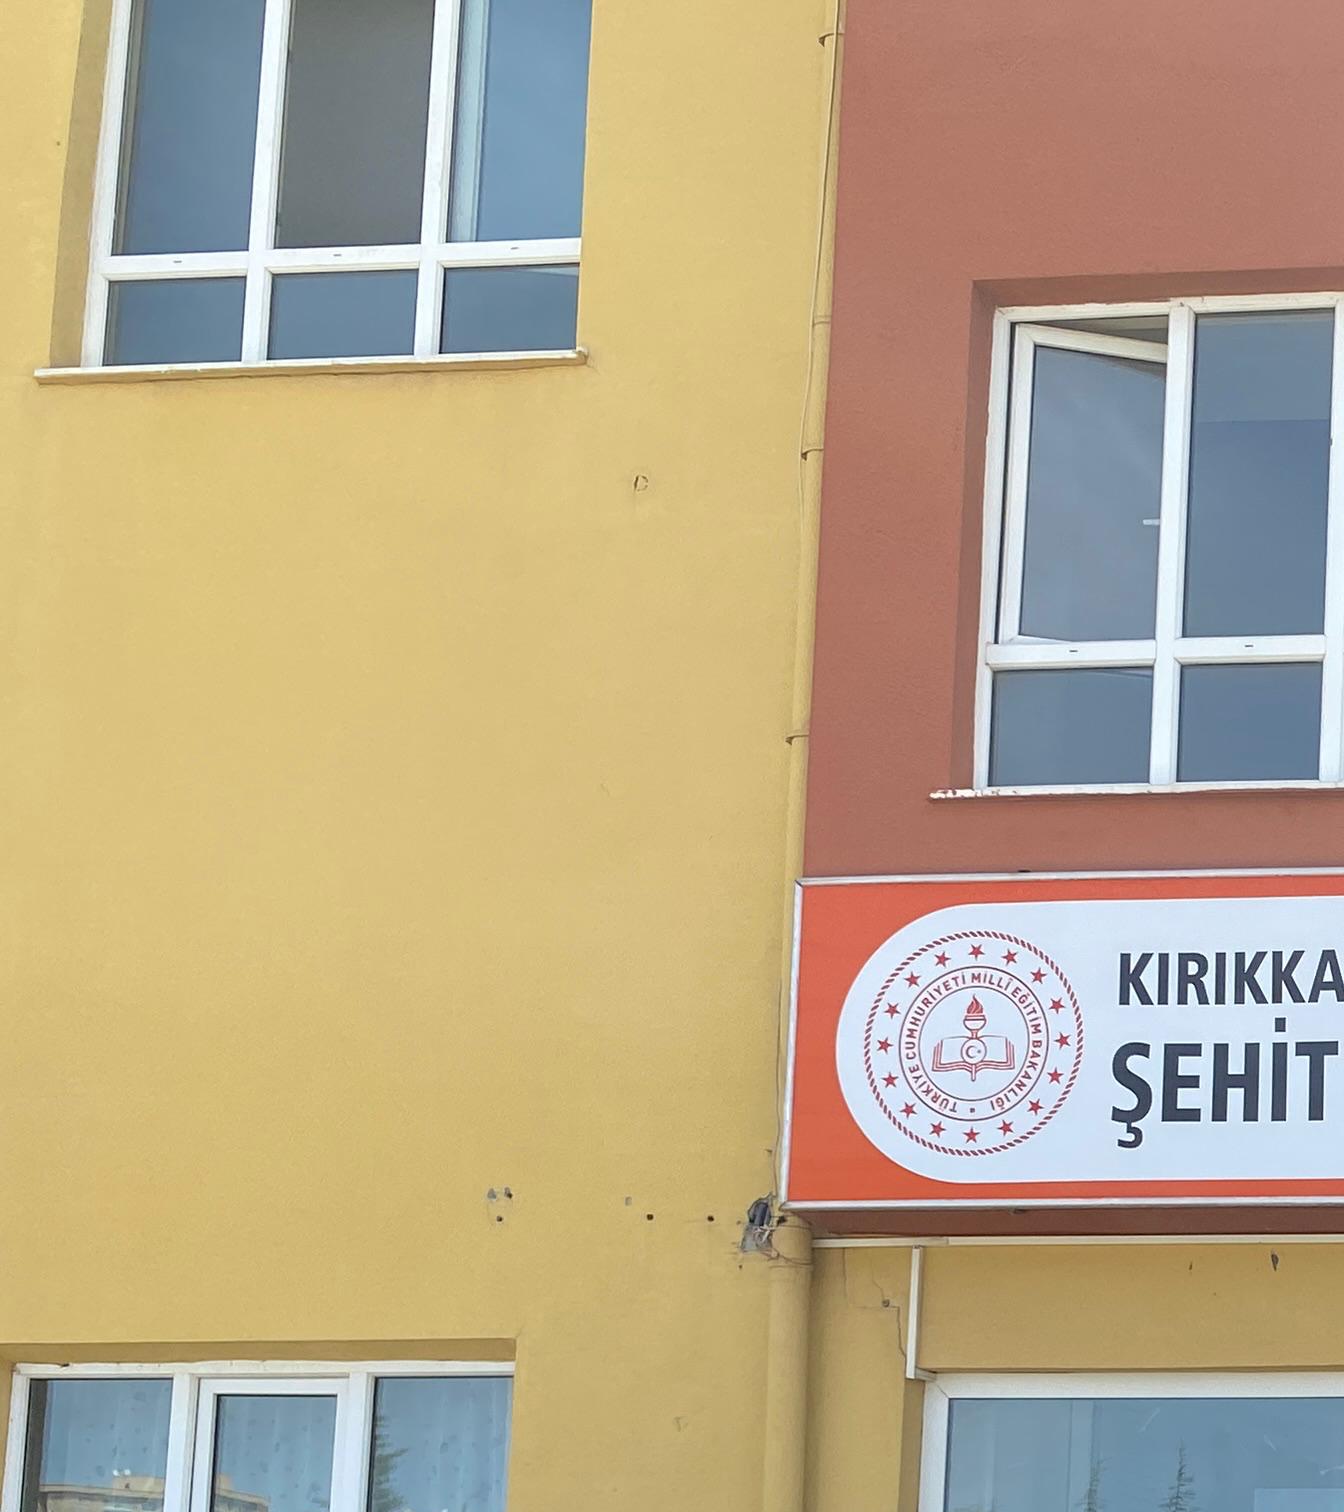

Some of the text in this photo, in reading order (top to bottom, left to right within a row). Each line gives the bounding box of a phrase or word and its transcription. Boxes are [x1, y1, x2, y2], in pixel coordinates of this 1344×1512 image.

[905, 973, 967, 1060] CUMHURİYETİ
[1011, 989, 1042, 1035] EĞİTİM
[908, 1064, 958, 1113] TÜRKİYE
[990, 1040, 1043, 1111] BAKANLIĞI
[1111, 1017, 1339, 1149] ŞEHİT
